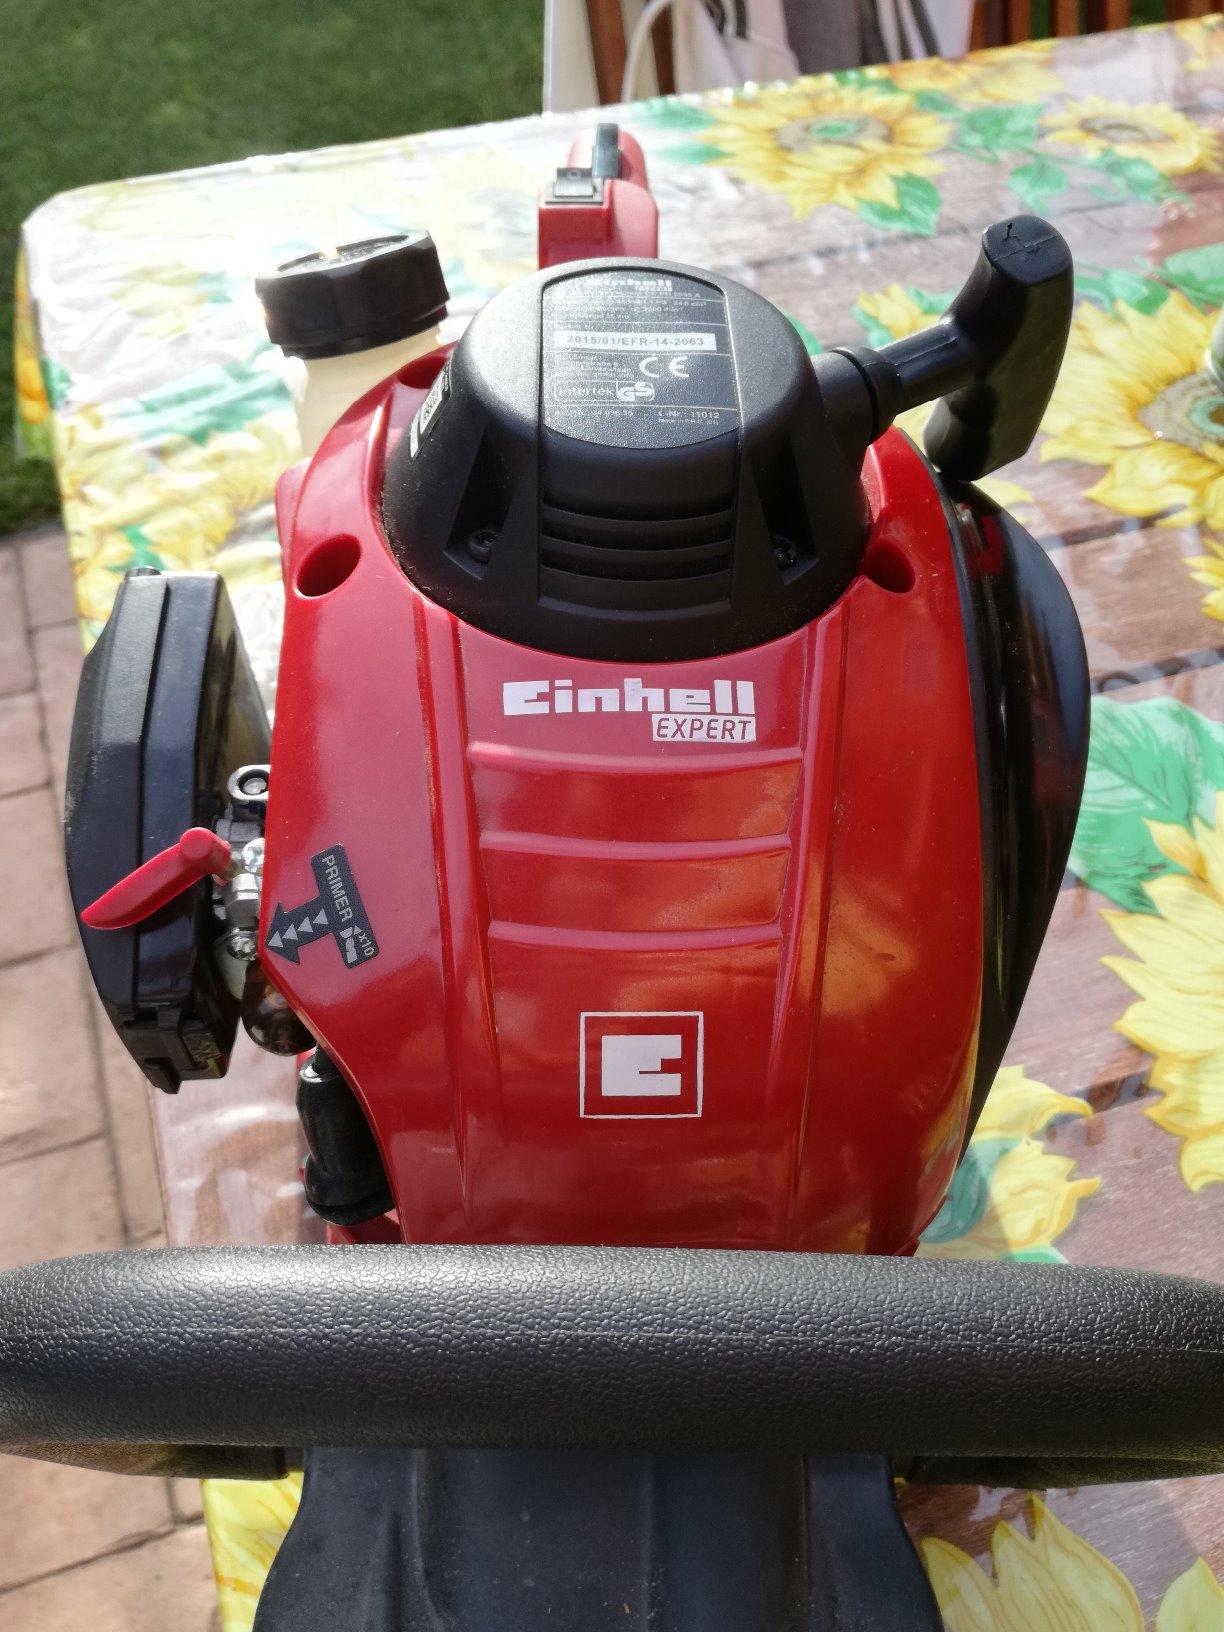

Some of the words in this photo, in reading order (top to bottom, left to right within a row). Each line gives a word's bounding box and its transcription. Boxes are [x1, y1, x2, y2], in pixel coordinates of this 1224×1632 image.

[566, 334, 704, 347] 2015/01/EFR-14-2063
[639, 355, 690, 378] CE
[690, 410, 720, 419] 11012
[503, 678, 755, 715] Einhell
[655, 716, 752, 741] EXPERT
[321, 854, 353, 922] PRIMER
